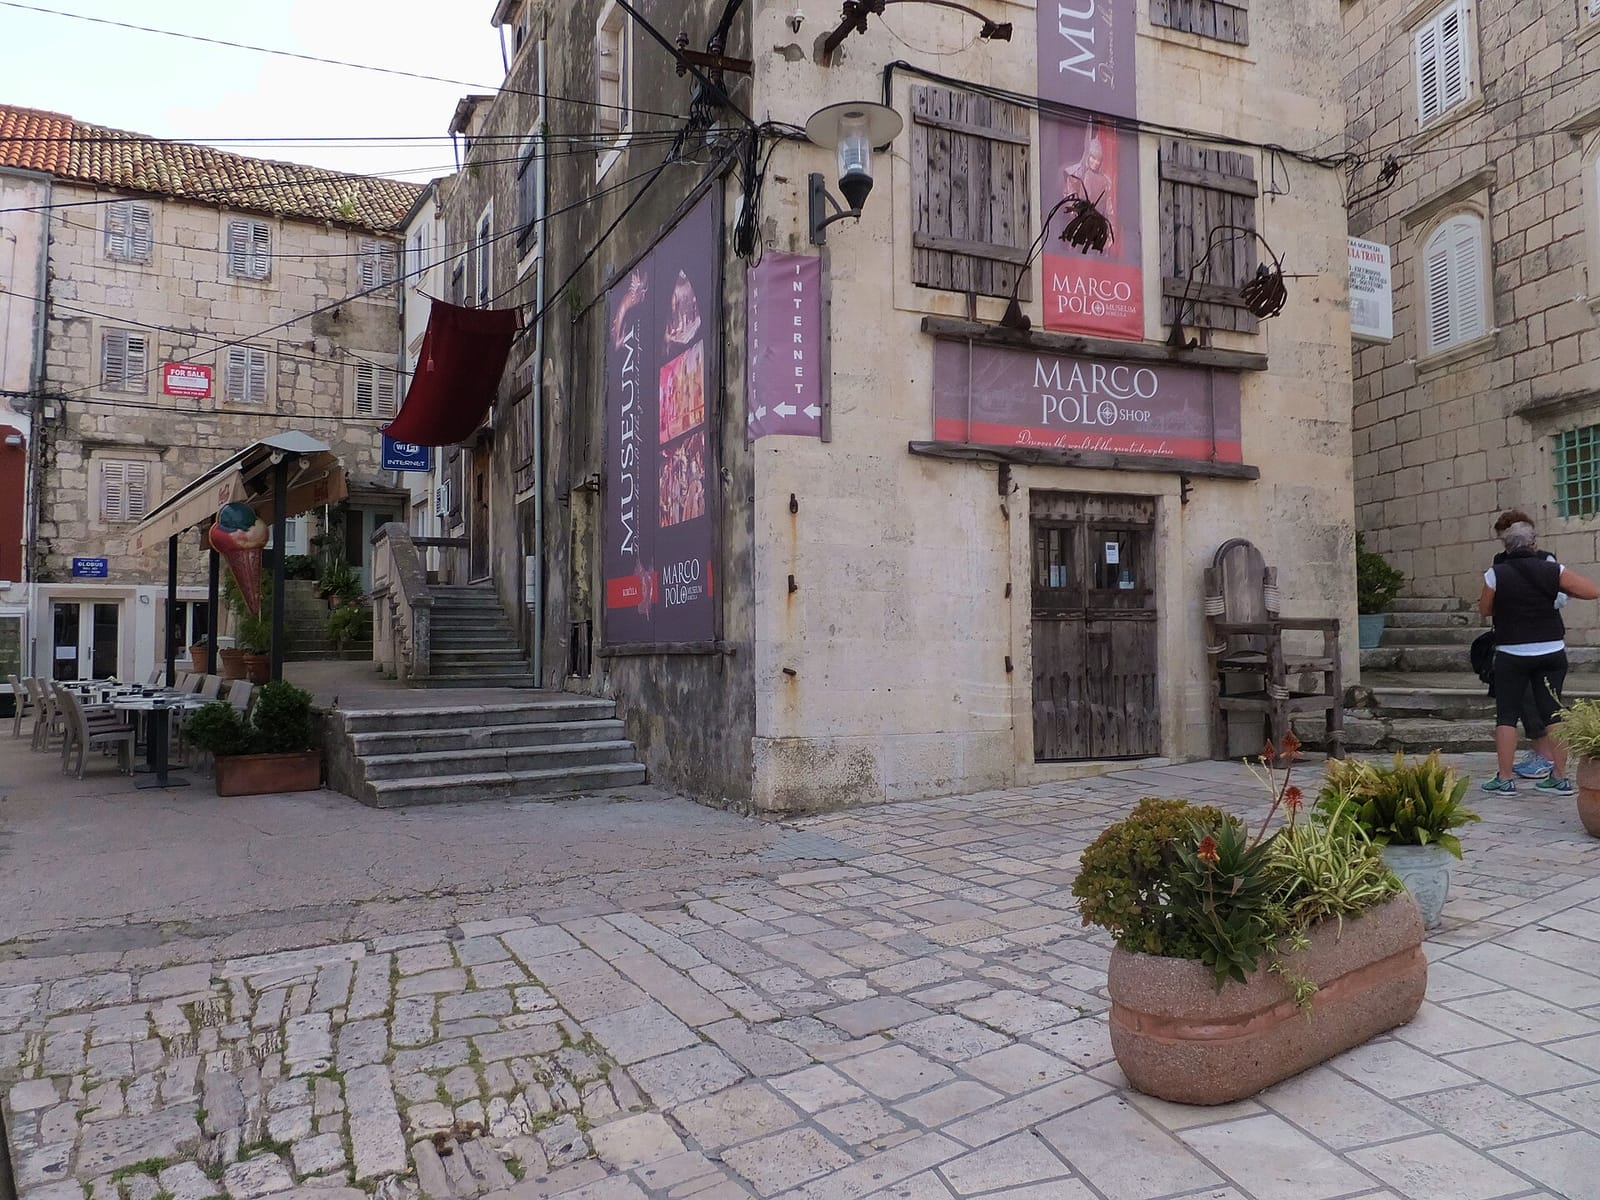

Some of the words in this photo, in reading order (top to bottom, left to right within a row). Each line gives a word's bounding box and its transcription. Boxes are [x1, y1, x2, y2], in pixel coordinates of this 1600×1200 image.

[1360, 250, 1385, 264] TRAVEL
[1053, 272, 1131, 301] MARCO
[1058, 295, 1105, 317] POLO
[1106, 304, 1137, 313] MUSEUM
[793, 264, 804, 394] INTERNET
[170, 369, 186, 377] FOR
[186, 370, 206, 378] SALE
[1033, 357, 1158, 399] MARCO
[1041, 393, 1118, 426] POLO
[1119, 408, 1151, 422] SHOP
[620, 325, 635, 556] MUSEUM
[387, 459, 425, 467] INTERNET
[662, 558, 700, 585] MARCO
[665, 583, 688, 608] POLO
